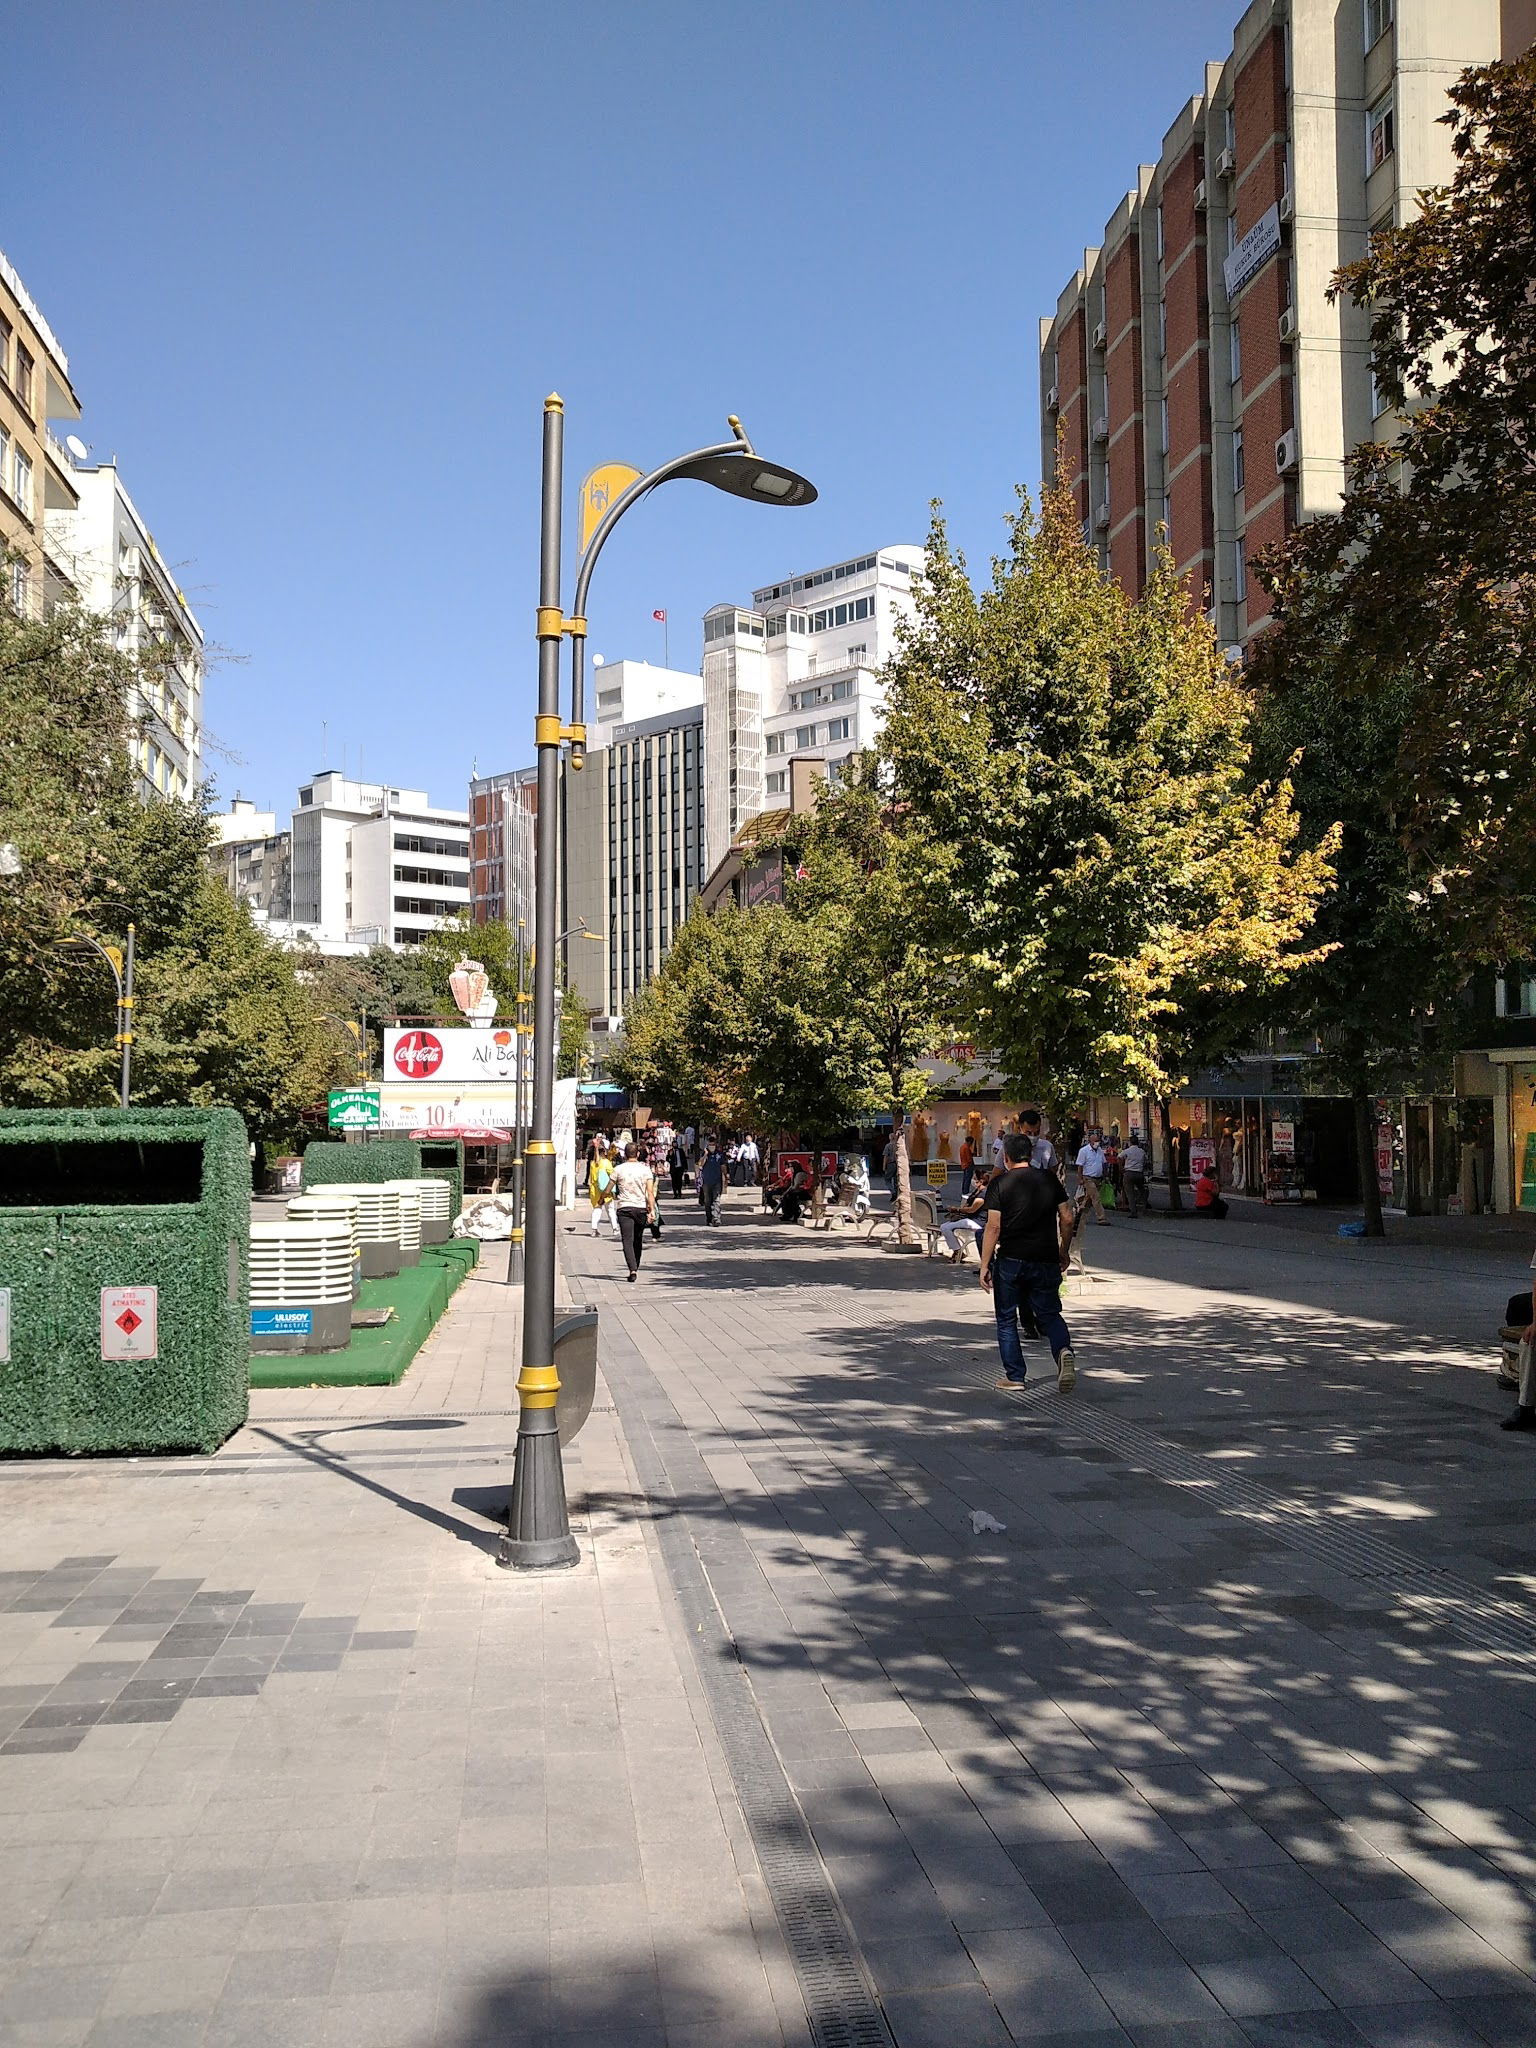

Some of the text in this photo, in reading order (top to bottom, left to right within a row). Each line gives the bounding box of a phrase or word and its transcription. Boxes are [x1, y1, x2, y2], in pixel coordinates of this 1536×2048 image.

[472, 1045, 492, 1063] Ali
[425, 1105, 445, 1126] 10
[274, 1312, 309, 1321] ULUSOY
